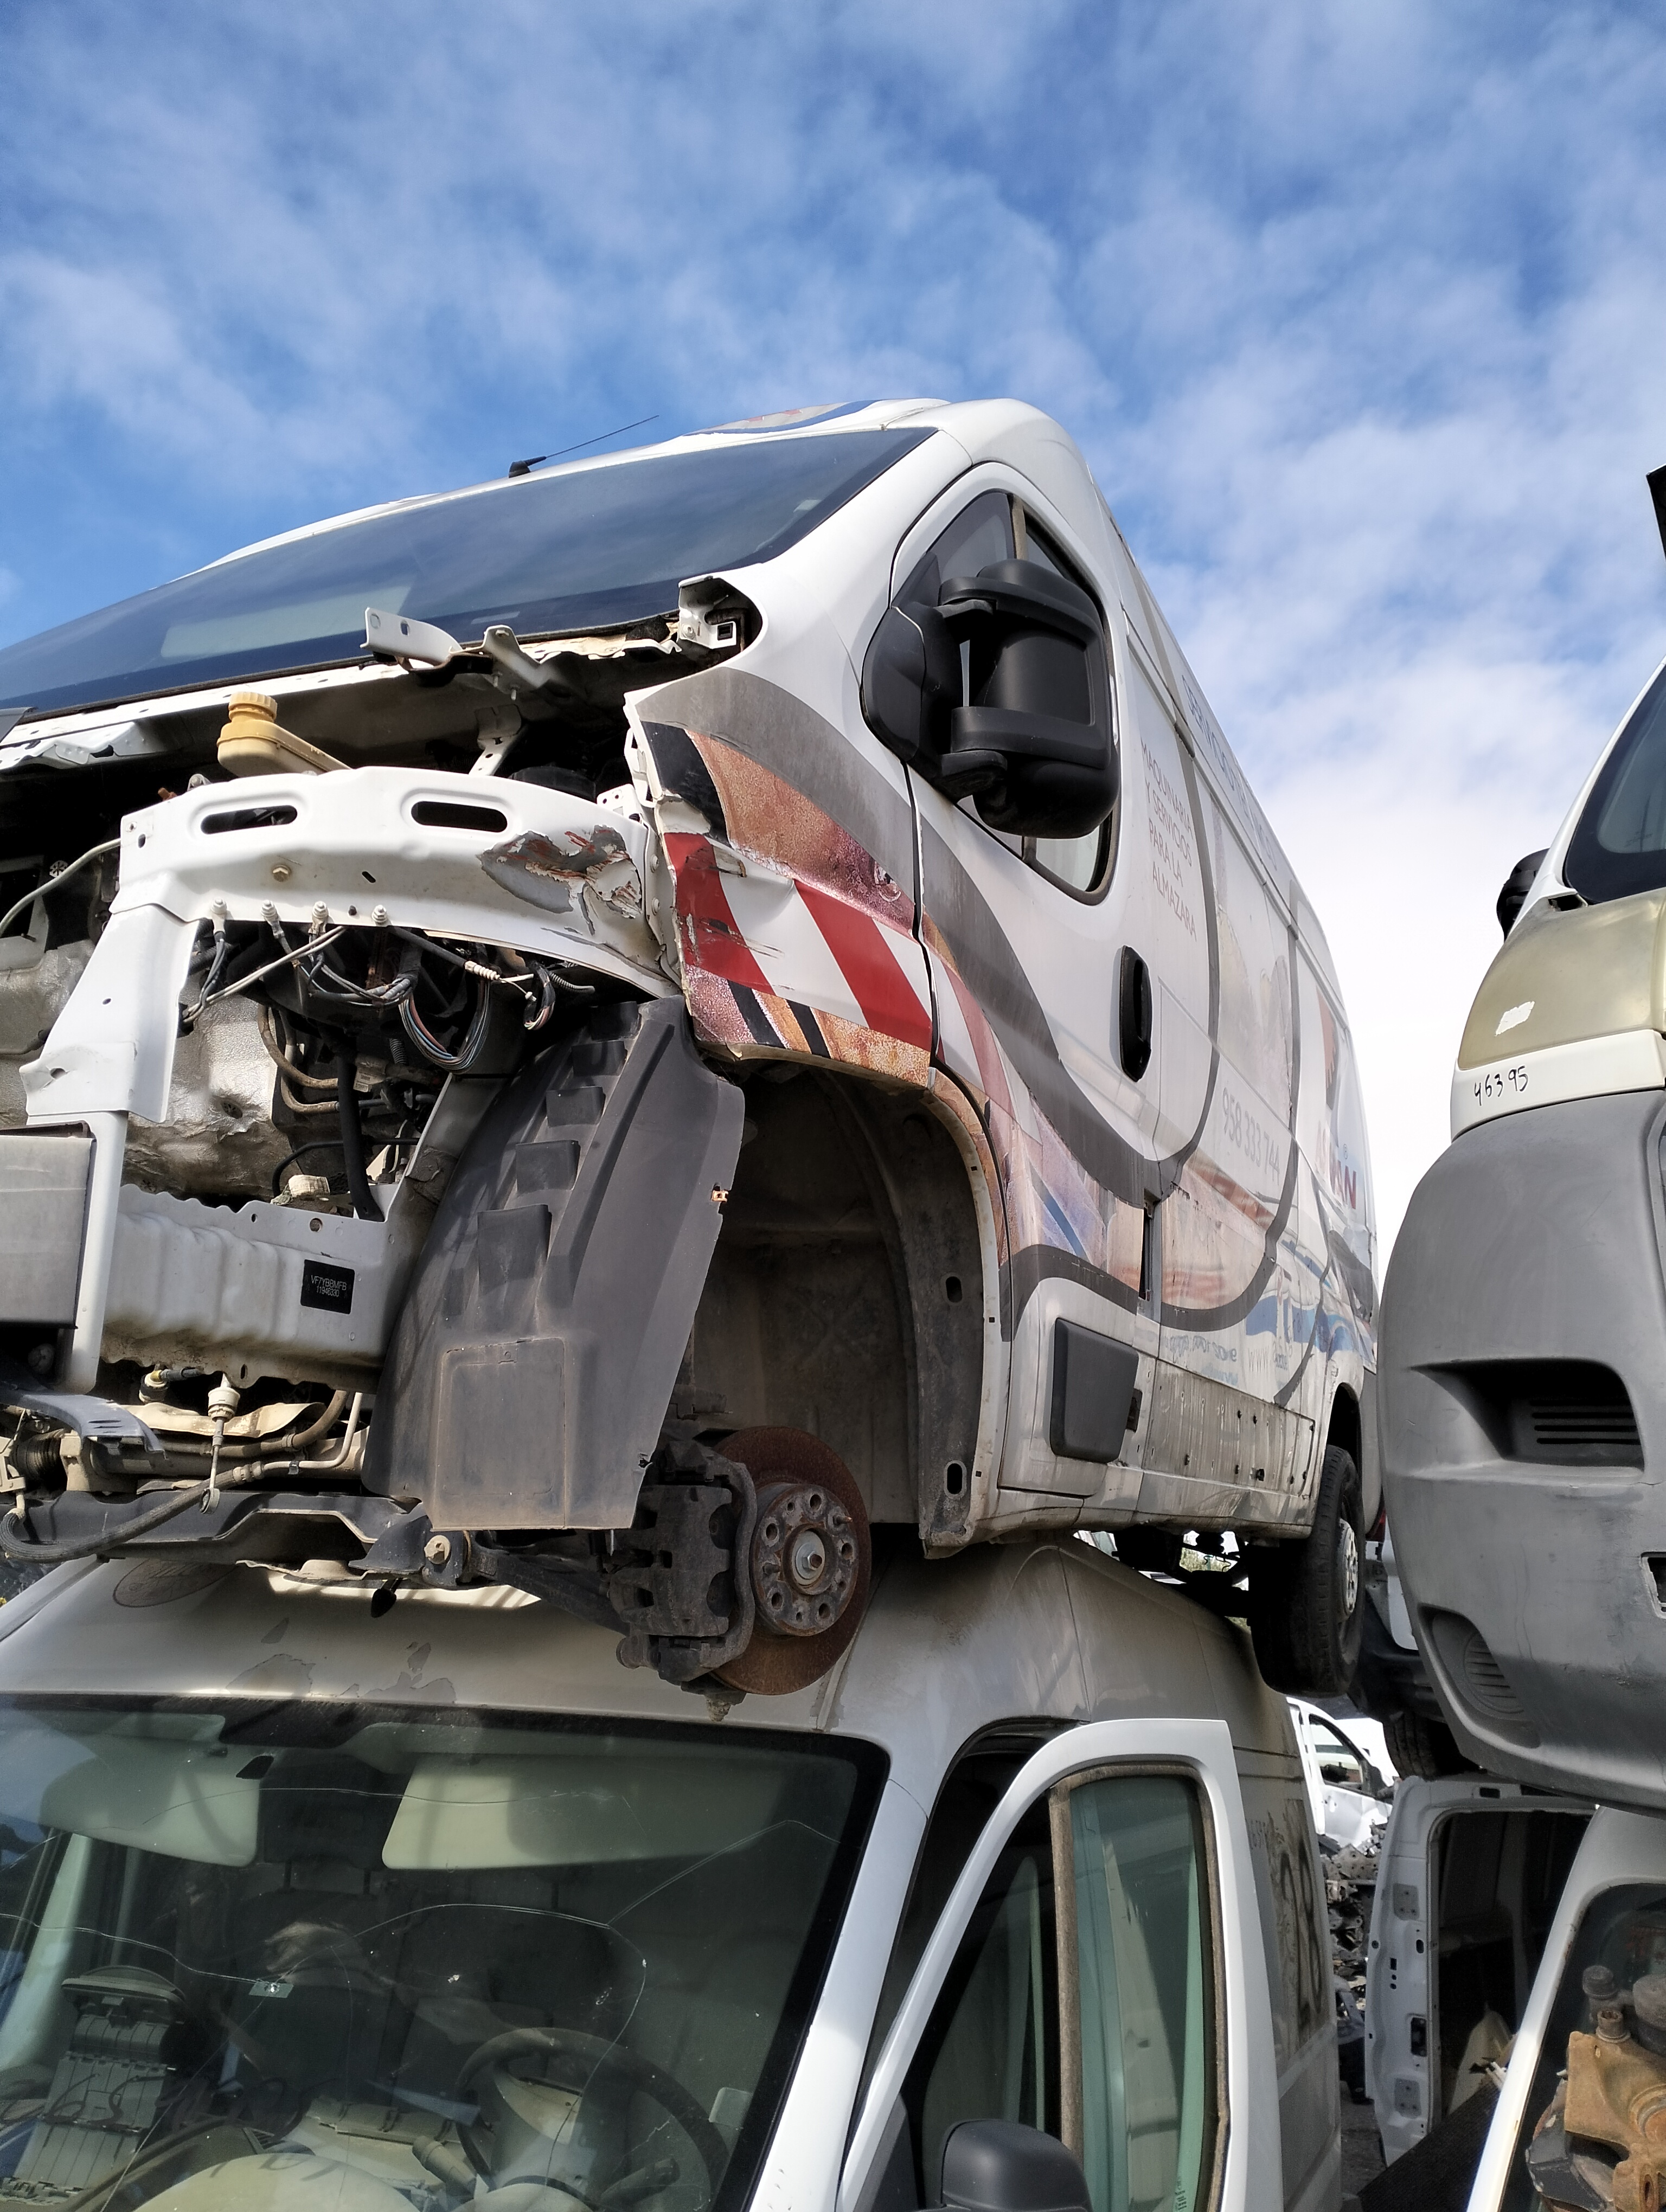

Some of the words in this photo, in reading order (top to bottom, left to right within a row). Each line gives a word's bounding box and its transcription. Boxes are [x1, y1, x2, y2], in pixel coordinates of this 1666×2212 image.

[1182, 674, 1235, 791] SERVICIO
[1140, 736, 1193, 840] MAQUINARIA
[1145, 777, 1150, 803] Y
[1153, 789, 1192, 867] SERVICIOS
[1149, 817, 1171, 870] PARA
[1172, 852, 1183, 888] LA
[1152, 861, 1197, 942] ALMAZARA
[1222, 1087, 1242, 1148] 958
[1245, 1110, 1261, 1168] 333
[1264, 1131, 1280, 1186] 744
